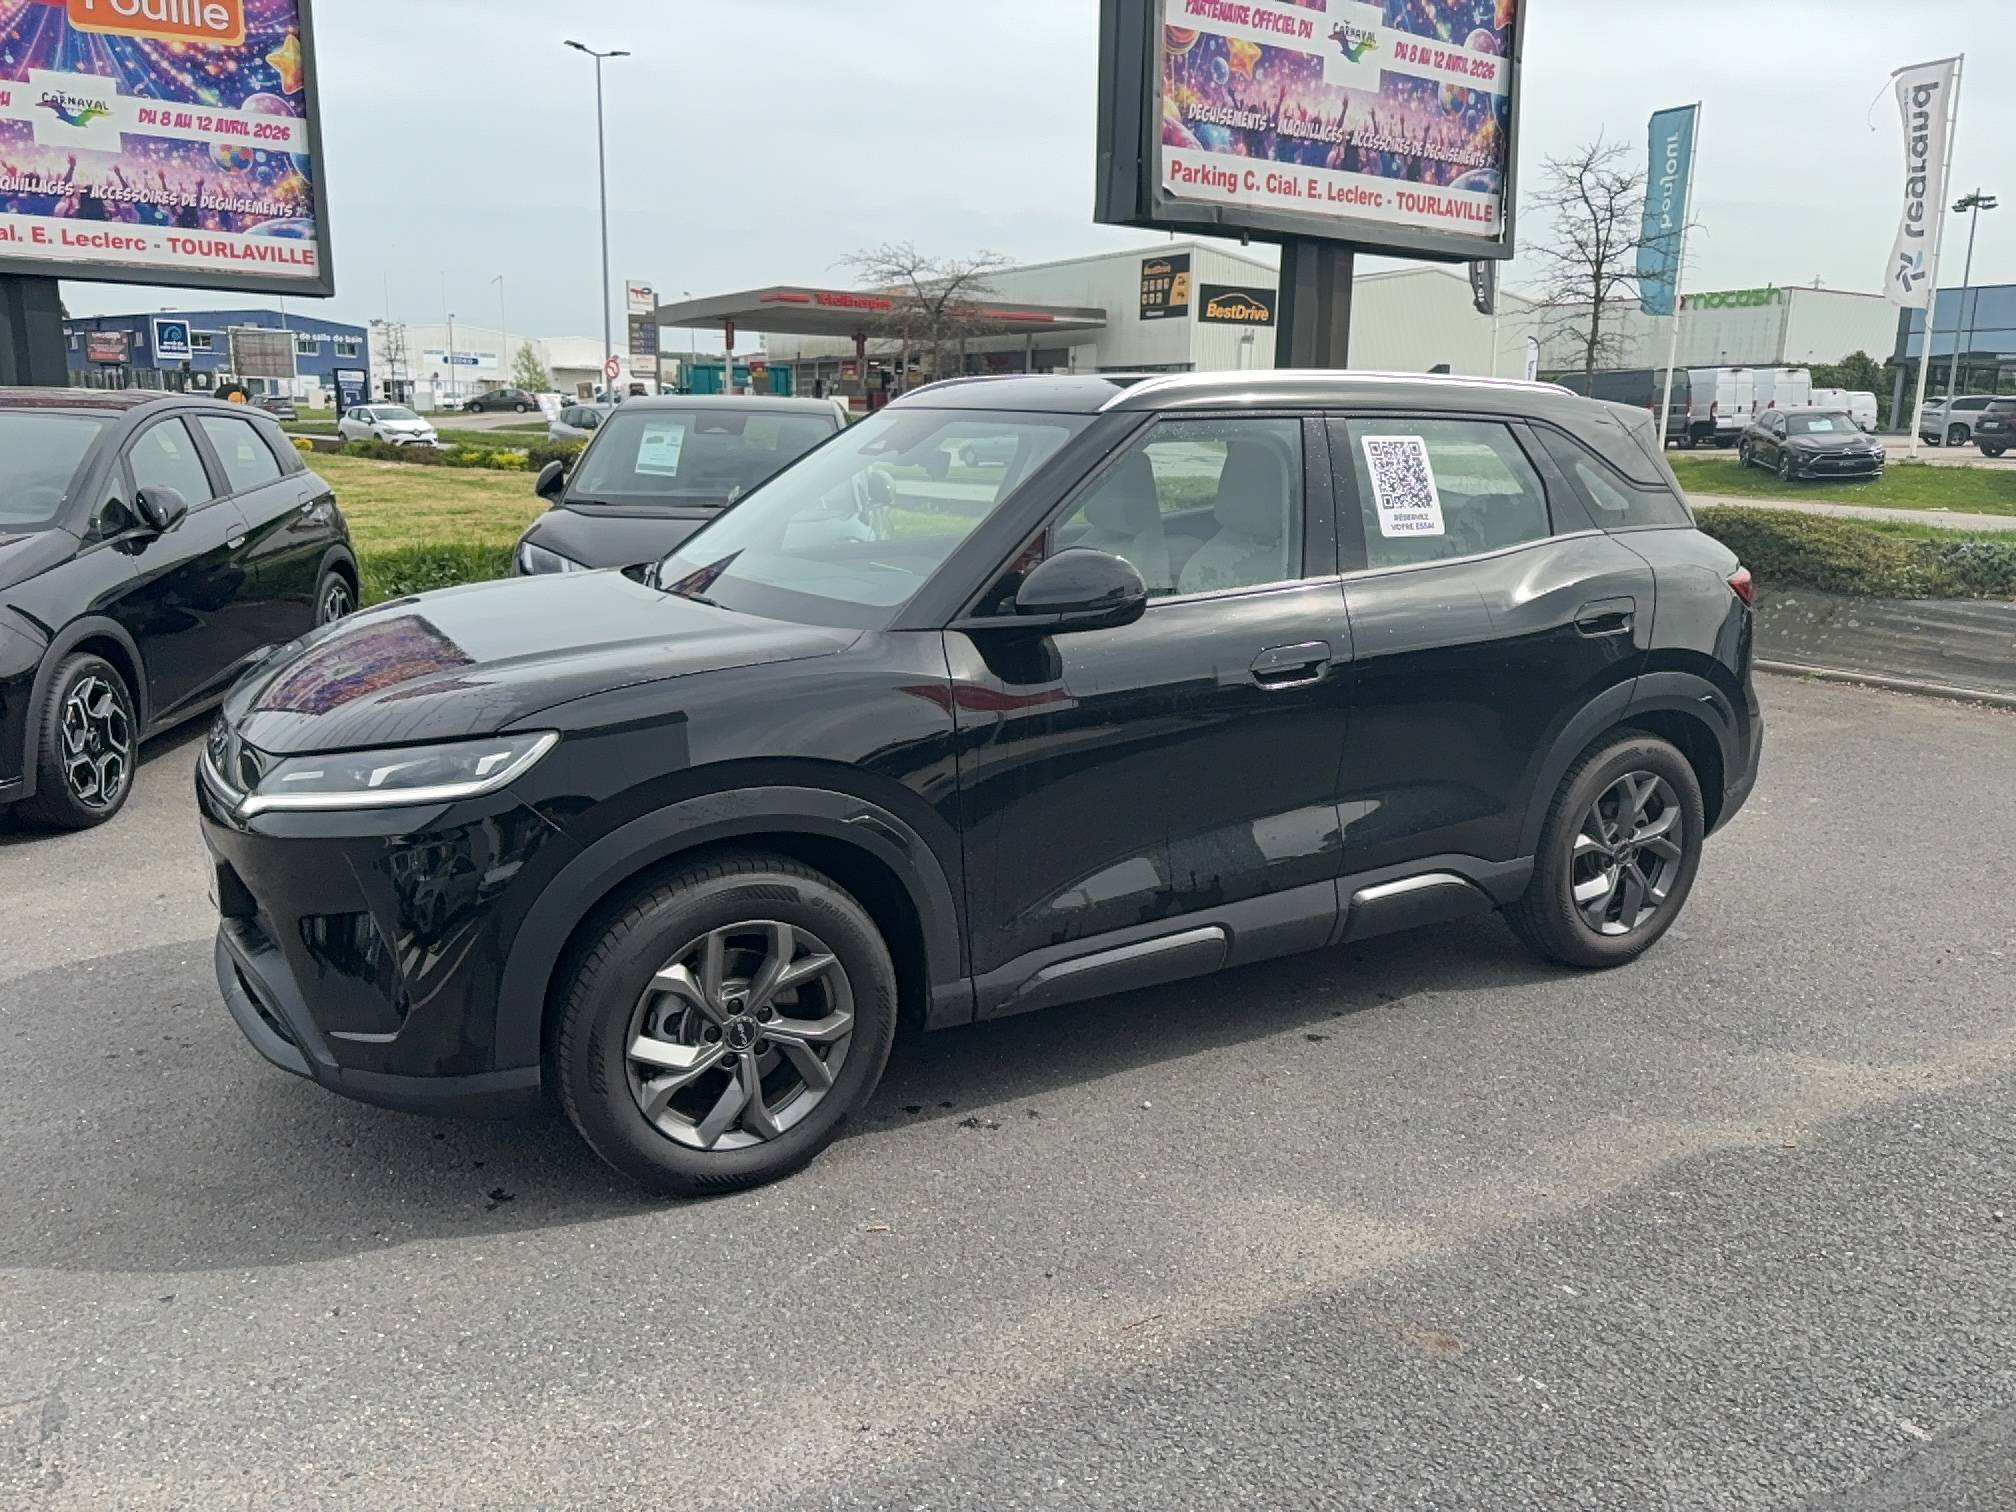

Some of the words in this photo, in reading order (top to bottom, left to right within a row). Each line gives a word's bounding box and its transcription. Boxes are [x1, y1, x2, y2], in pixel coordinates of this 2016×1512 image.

[85, 0, 230, 30] ouille
[1251, 8, 1296, 36] OFFICIEL
[1297, 19, 1313, 39] DU
[1394, 42, 1407, 61] DU
[1408, 44, 1416, 62] 8
[1418, 48, 1432, 66] AU
[1434, 51, 1445, 69] 12
[1445, 54, 1468, 74] AVRIL
[1470, 59, 1495, 80] 2026
[138, 107, 157, 125] DU
[160, 111, 171, 126] 8
[174, 113, 193, 129] AU
[196, 115, 212, 131] 12
[214, 118, 250, 137] AVRIL
[253, 122, 291, 141] 2026
[1351, 129, 1411, 155] ACCESSOIRES
[1412, 143, 1423, 156] DE
[90, 183, 178, 207] ACCESSOIRES
[180, 193, 198, 208] DE
[1170, 159, 1238, 194] Parking
[1243, 170, 1261, 192] C.
[1265, 173, 1302, 198] Cial.
[1307, 179, 1323, 200] E.
[1327, 182, 1384, 209] Leclerc
[1396, 191, 1493, 223] TOURLAVILLE
[31, 226, 53, 245] E.
[61, 228, 147, 251] Leclerc
[166, 237, 315, 266] TOURLAVILLE
[1206, 303, 1270, 321] BestDrive
